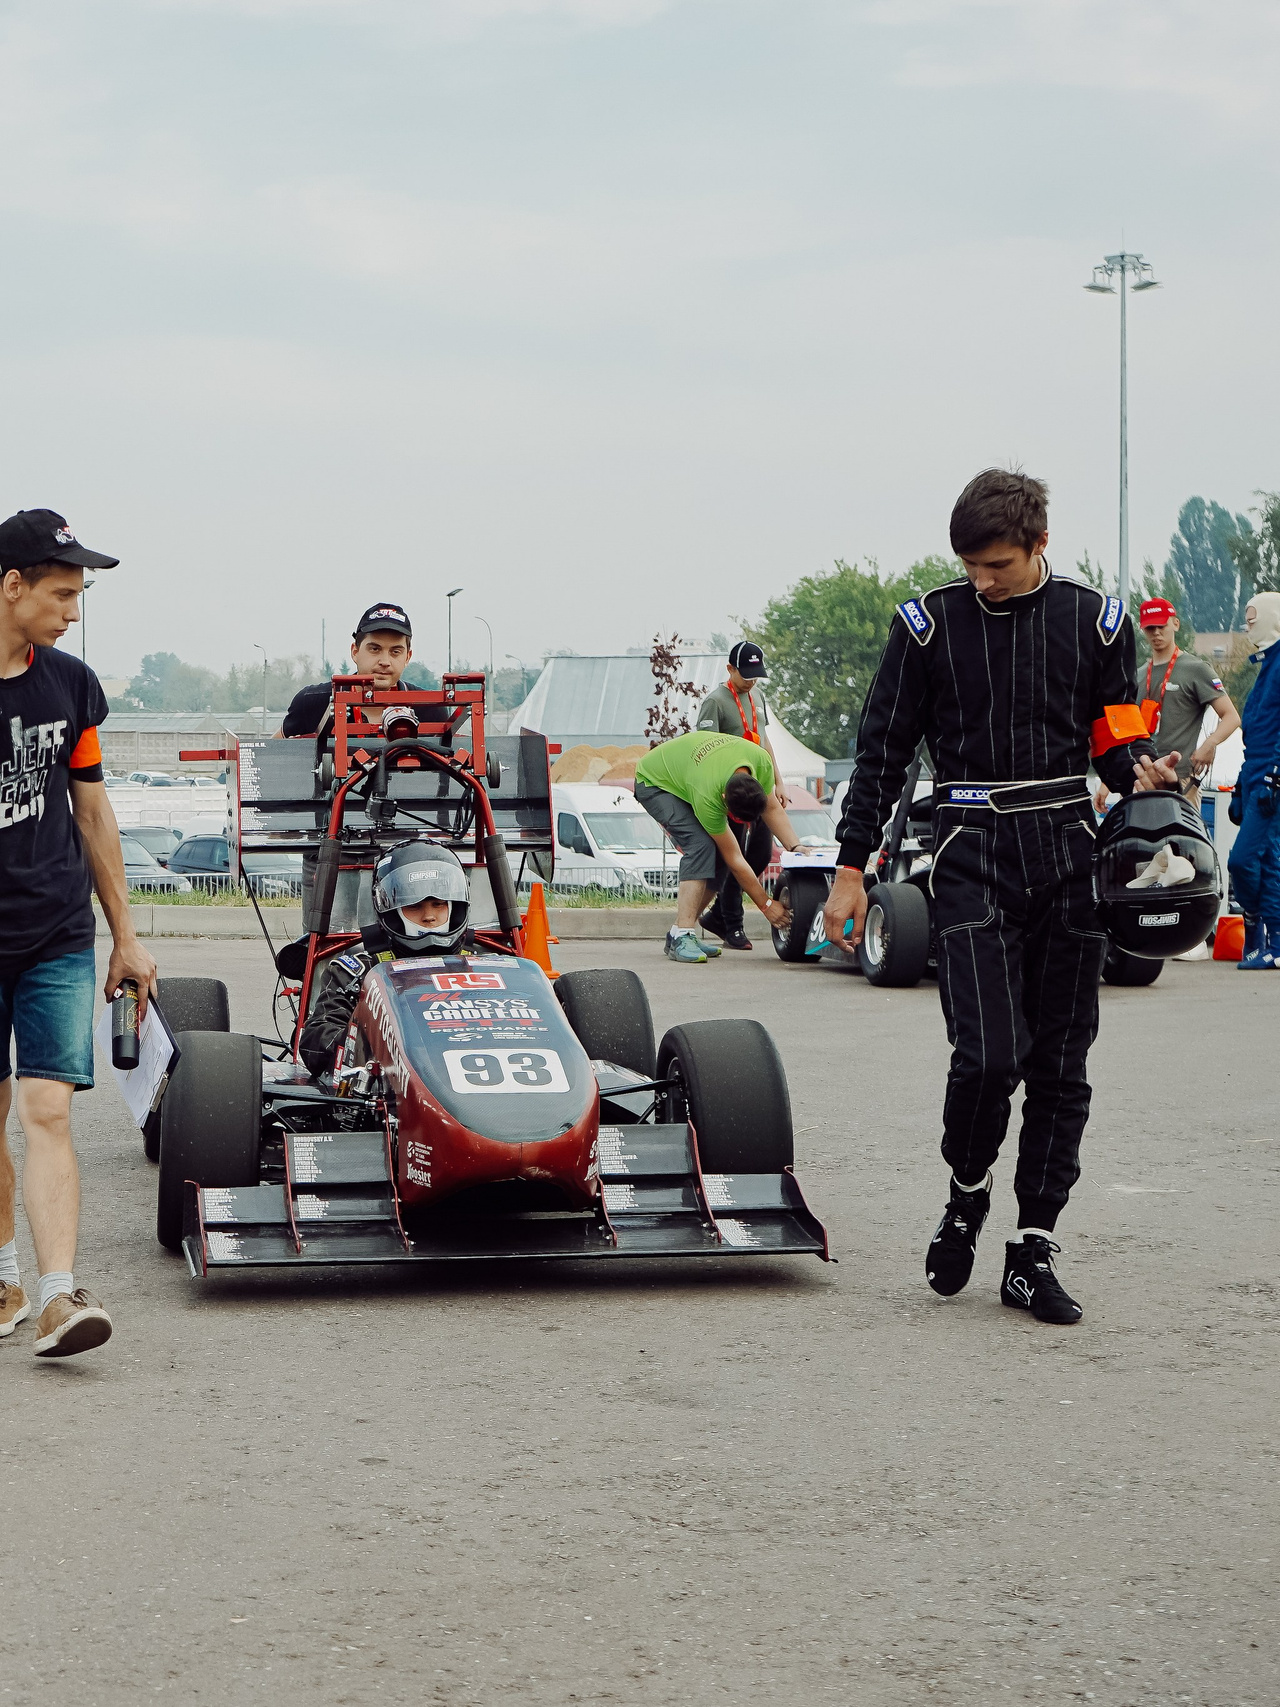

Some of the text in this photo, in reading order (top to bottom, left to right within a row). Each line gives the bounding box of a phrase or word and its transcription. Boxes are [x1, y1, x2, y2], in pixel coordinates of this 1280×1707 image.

[904, 602, 927, 631] sparco
[1, 715, 68, 783] JEFF
[693, 738, 725, 767] ACADEMY
[951, 789, 989, 799] sparco
[410, 871, 437, 881] SIMPSON
[1141, 915, 1177, 925] SIMPSON
[436, 974, 502, 990] RS
[428, 1000, 530, 1010] ANSYS
[422, 1009, 541, 1021] CADFEM
[427, 1019, 544, 1029] STT
[460, 1053, 553, 1087] 93
